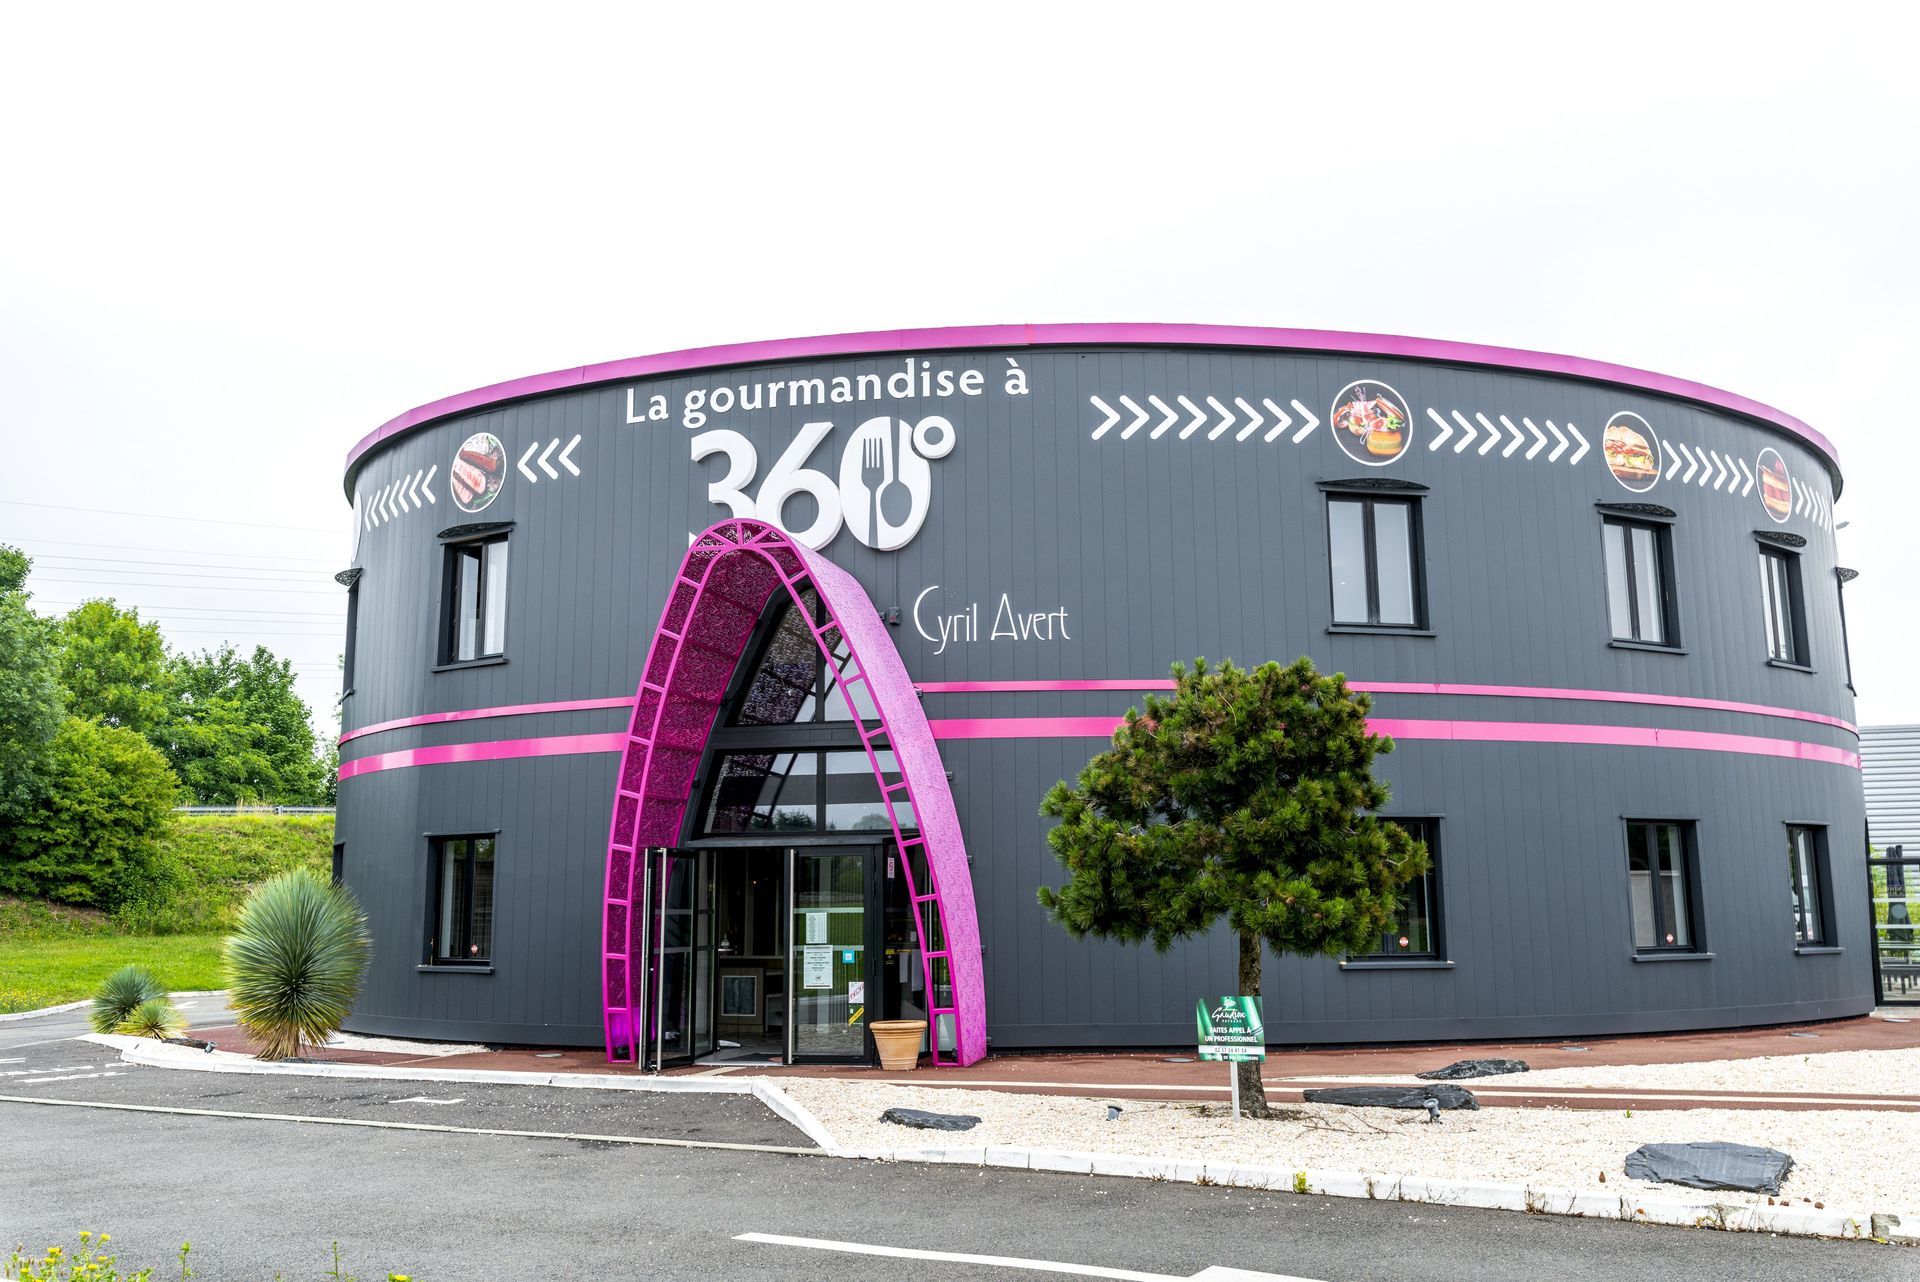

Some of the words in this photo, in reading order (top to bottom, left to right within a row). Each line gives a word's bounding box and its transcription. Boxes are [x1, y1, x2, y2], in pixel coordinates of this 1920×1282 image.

[626, 388, 669, 424] La
[682, 358, 985, 429] gourmandise
[1004, 357, 1030, 395] à
[913, 585, 977, 655] Cyril
[990, 593, 1071, 641] Avert
[1214, 1035, 1258, 1043] PROFESSIONNEL
